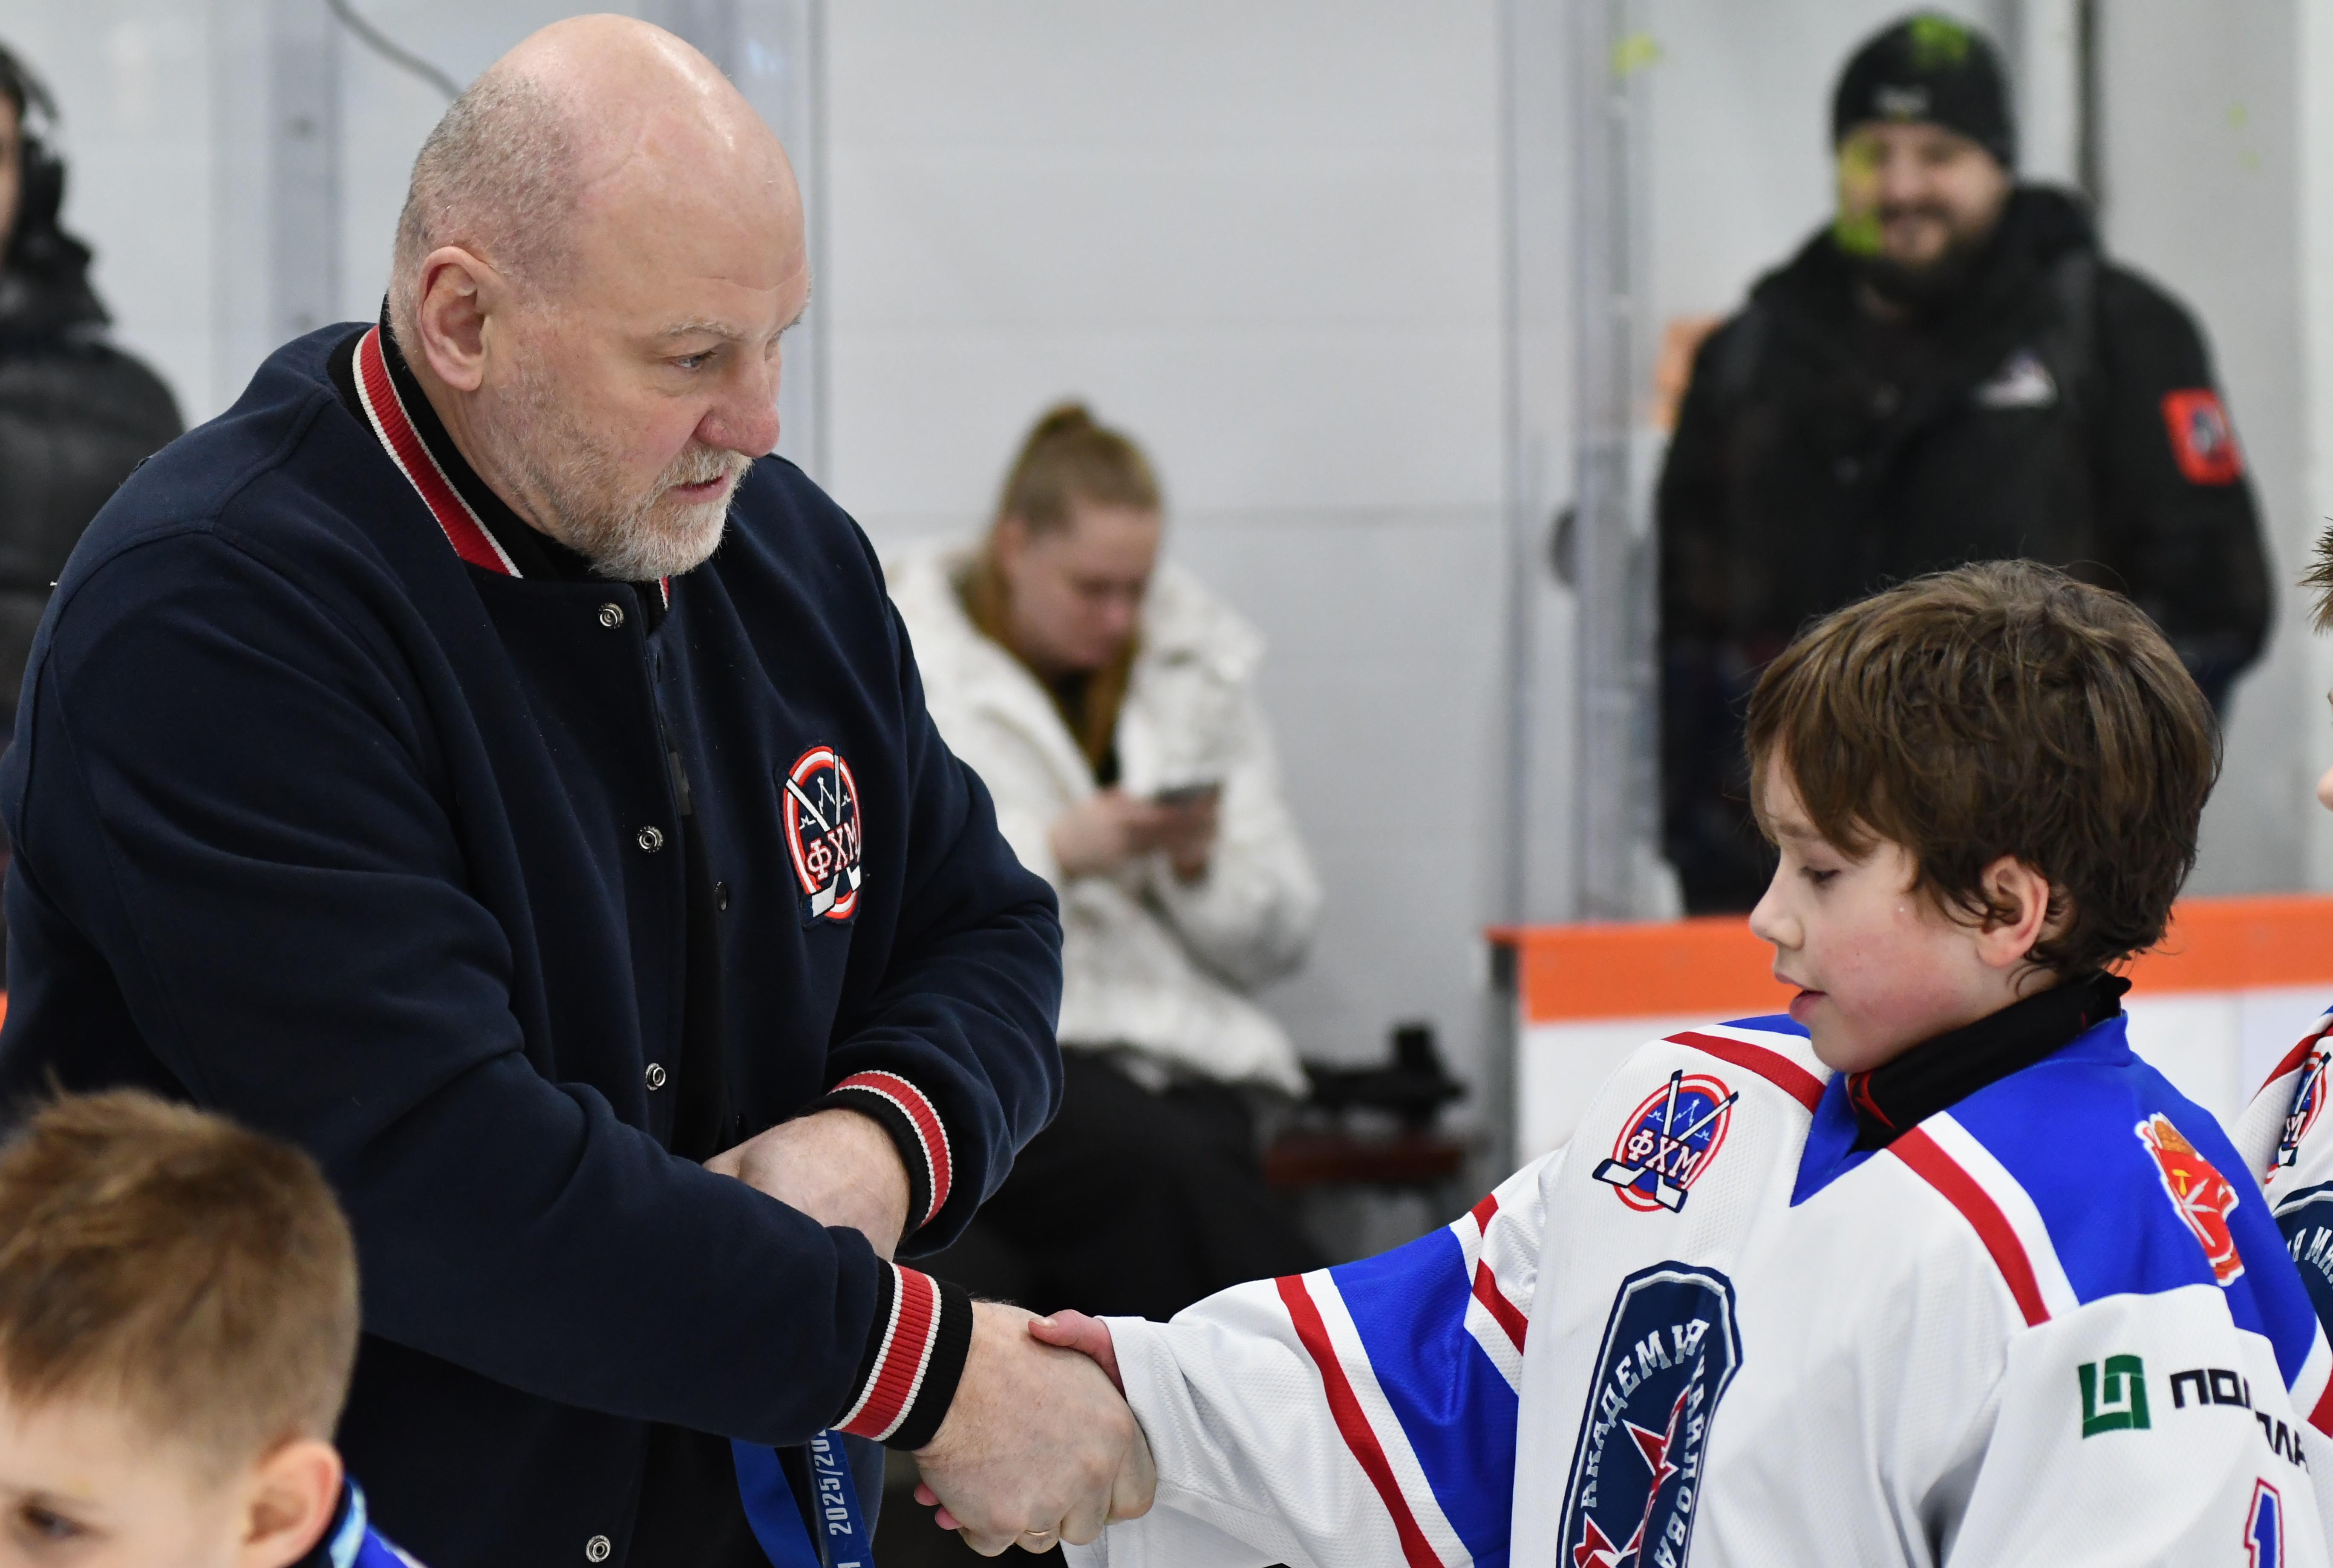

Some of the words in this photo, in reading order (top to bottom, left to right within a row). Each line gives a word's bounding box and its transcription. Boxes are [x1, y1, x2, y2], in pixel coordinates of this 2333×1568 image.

[806, 816, 861, 881] ФХМ
[1627, 1128, 1703, 1183] ФХМ
[1580, 1318, 1710, 1508] АКАДЕМИЯ
[810, 1429, 852, 1535] 2025/20
